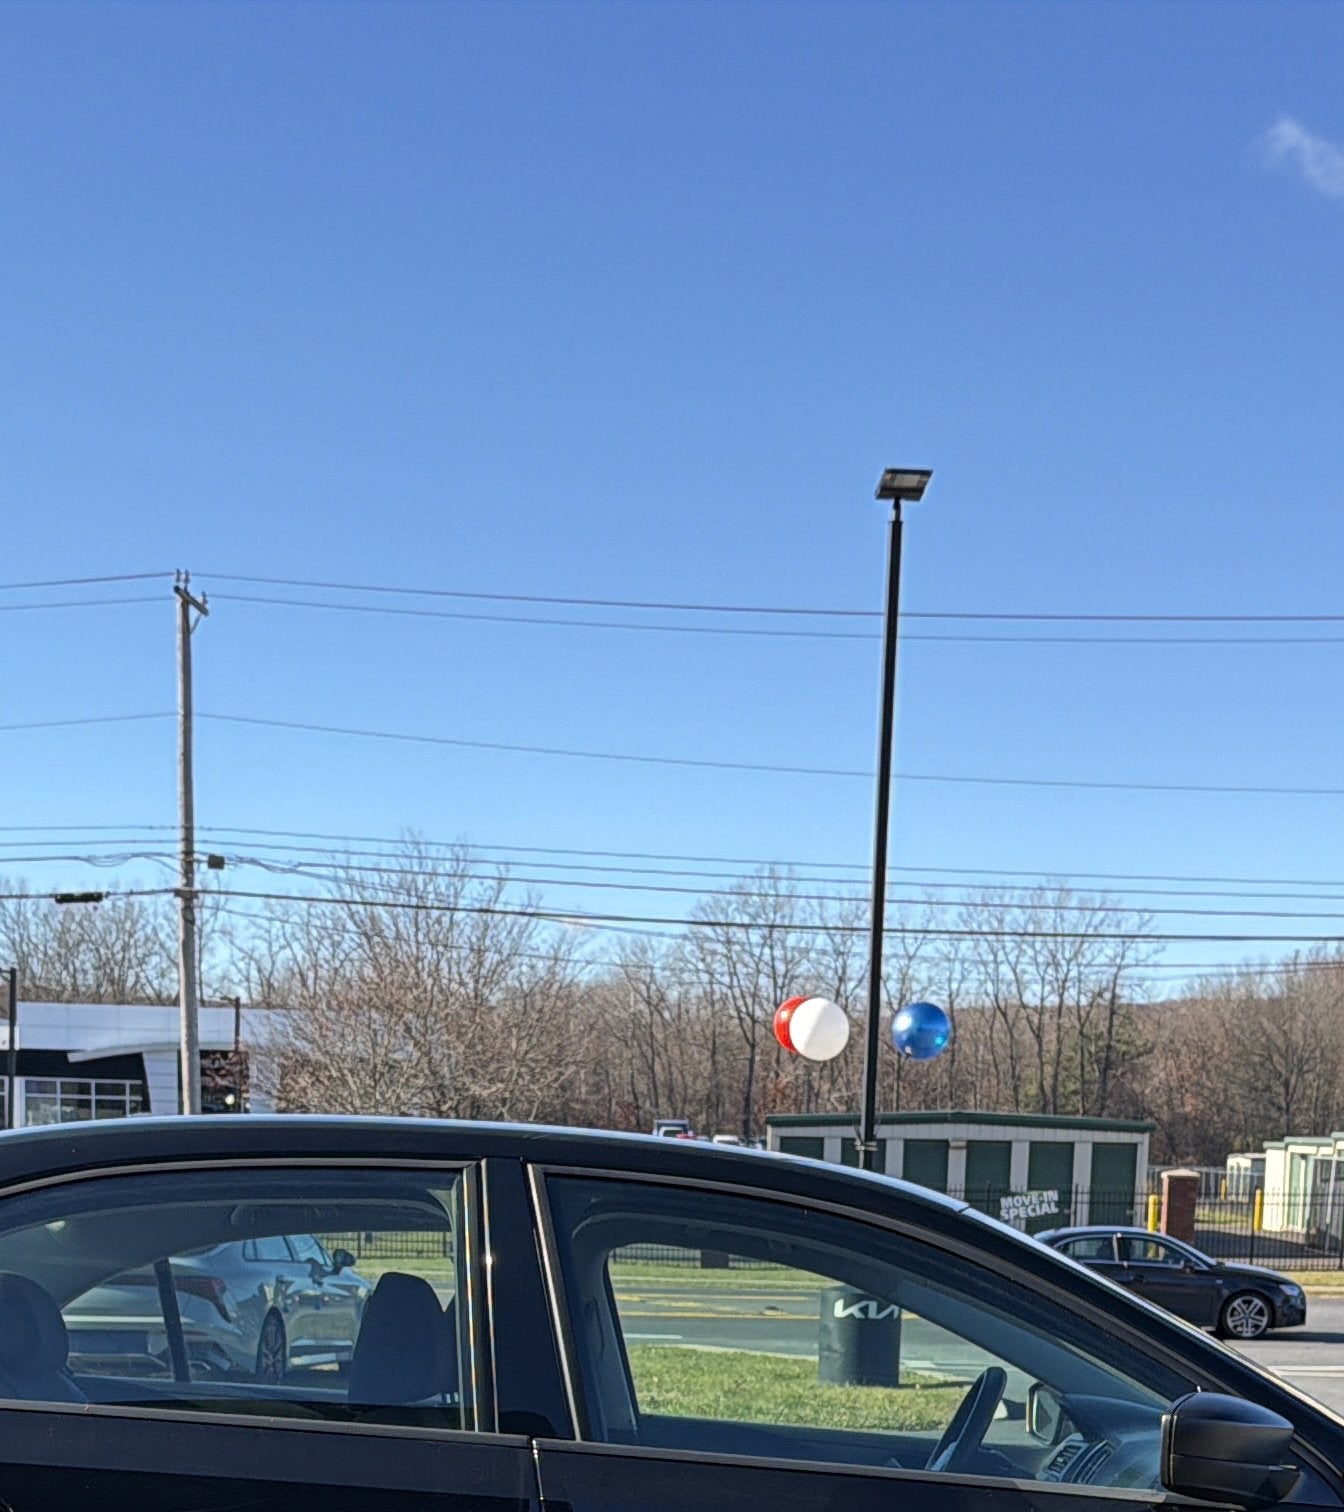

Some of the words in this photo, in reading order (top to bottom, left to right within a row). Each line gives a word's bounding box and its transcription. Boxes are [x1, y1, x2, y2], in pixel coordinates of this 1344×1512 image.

[1000, 1189, 1059, 1209] MOVE-IN
[1000, 1201, 1059, 1220] SPECIAL
[834, 1298, 900, 1320] KIA
